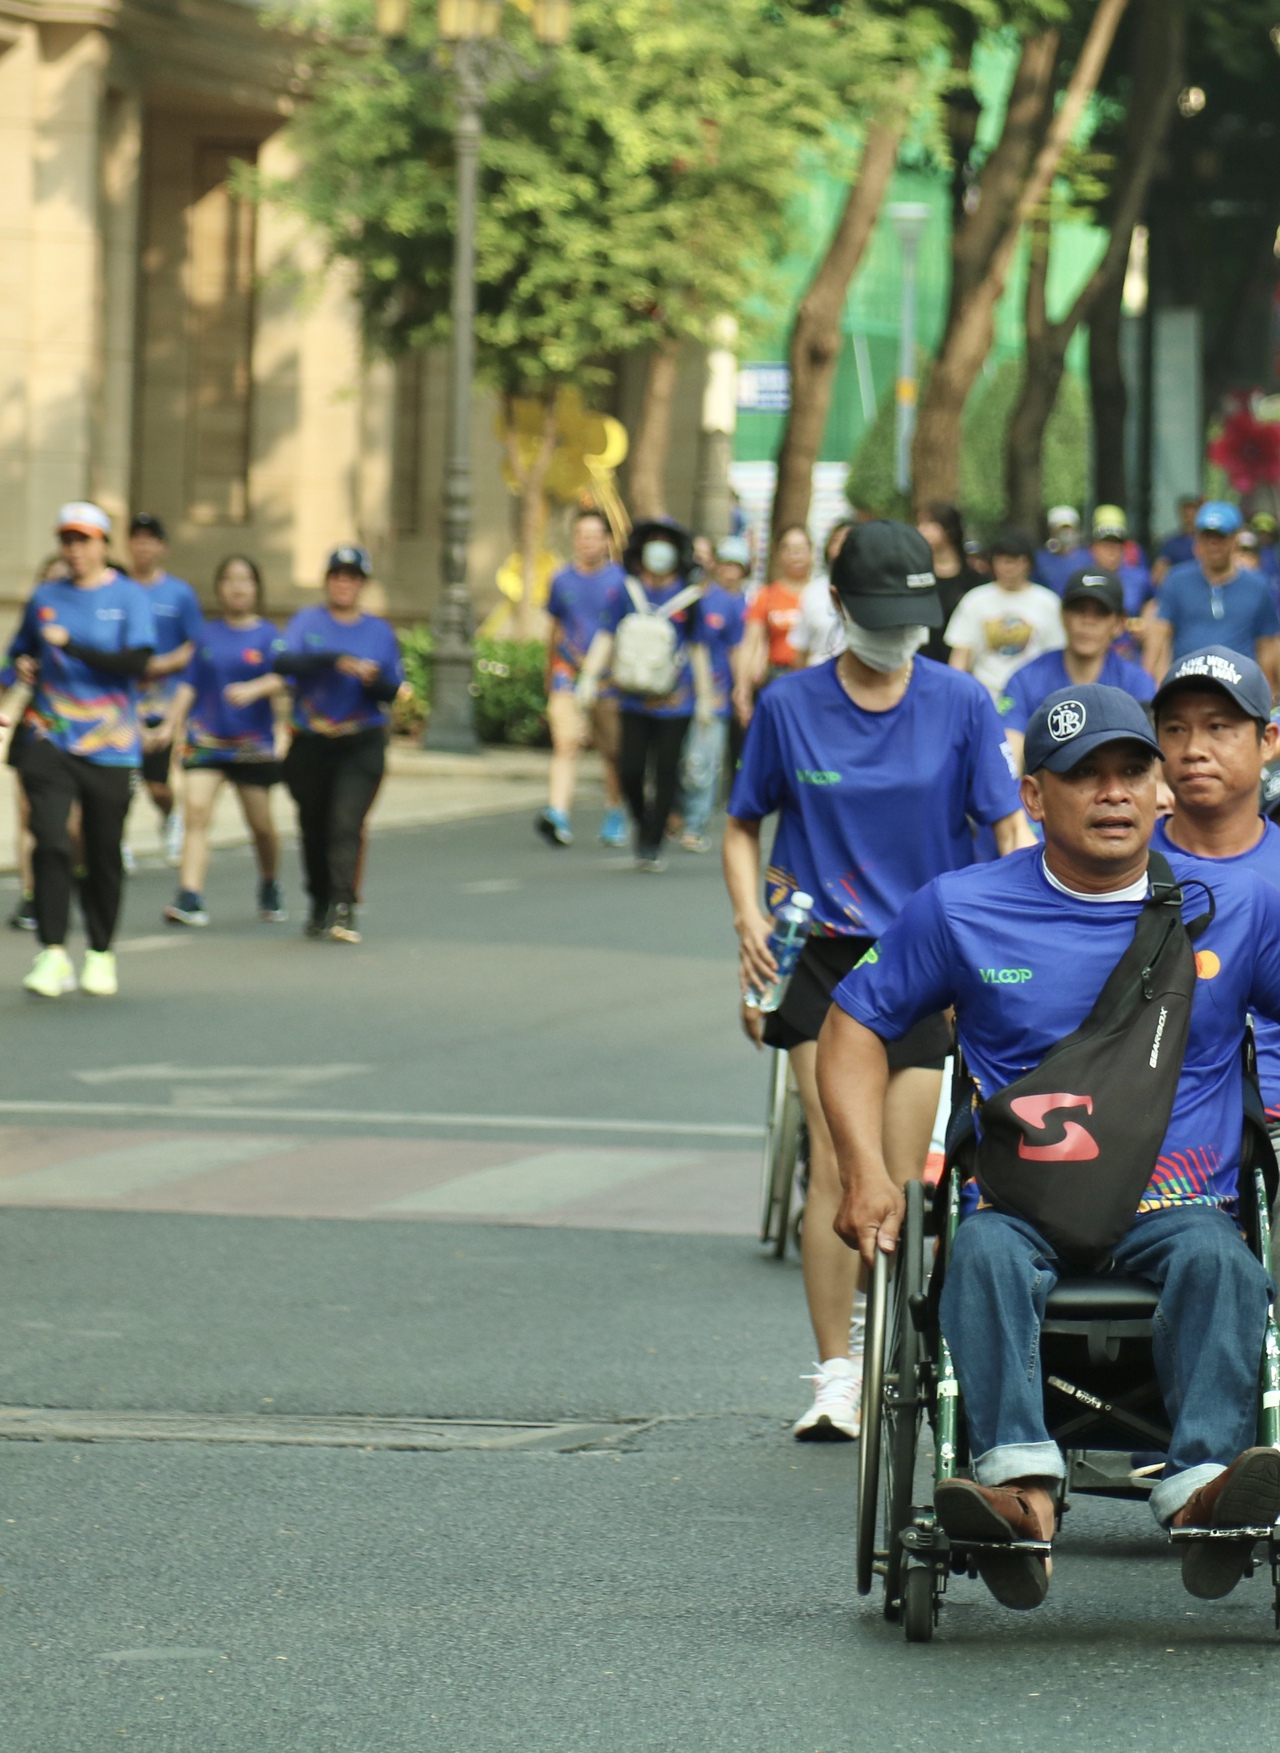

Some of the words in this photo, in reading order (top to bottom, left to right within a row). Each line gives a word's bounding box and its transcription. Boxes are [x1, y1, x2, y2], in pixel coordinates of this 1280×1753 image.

[1207, 654, 1236, 672] WELL
[1212, 666, 1242, 684] WAY
[979, 968, 1033, 984] VLOOP
[1149, 1005, 1169, 1069] GEARBOX
